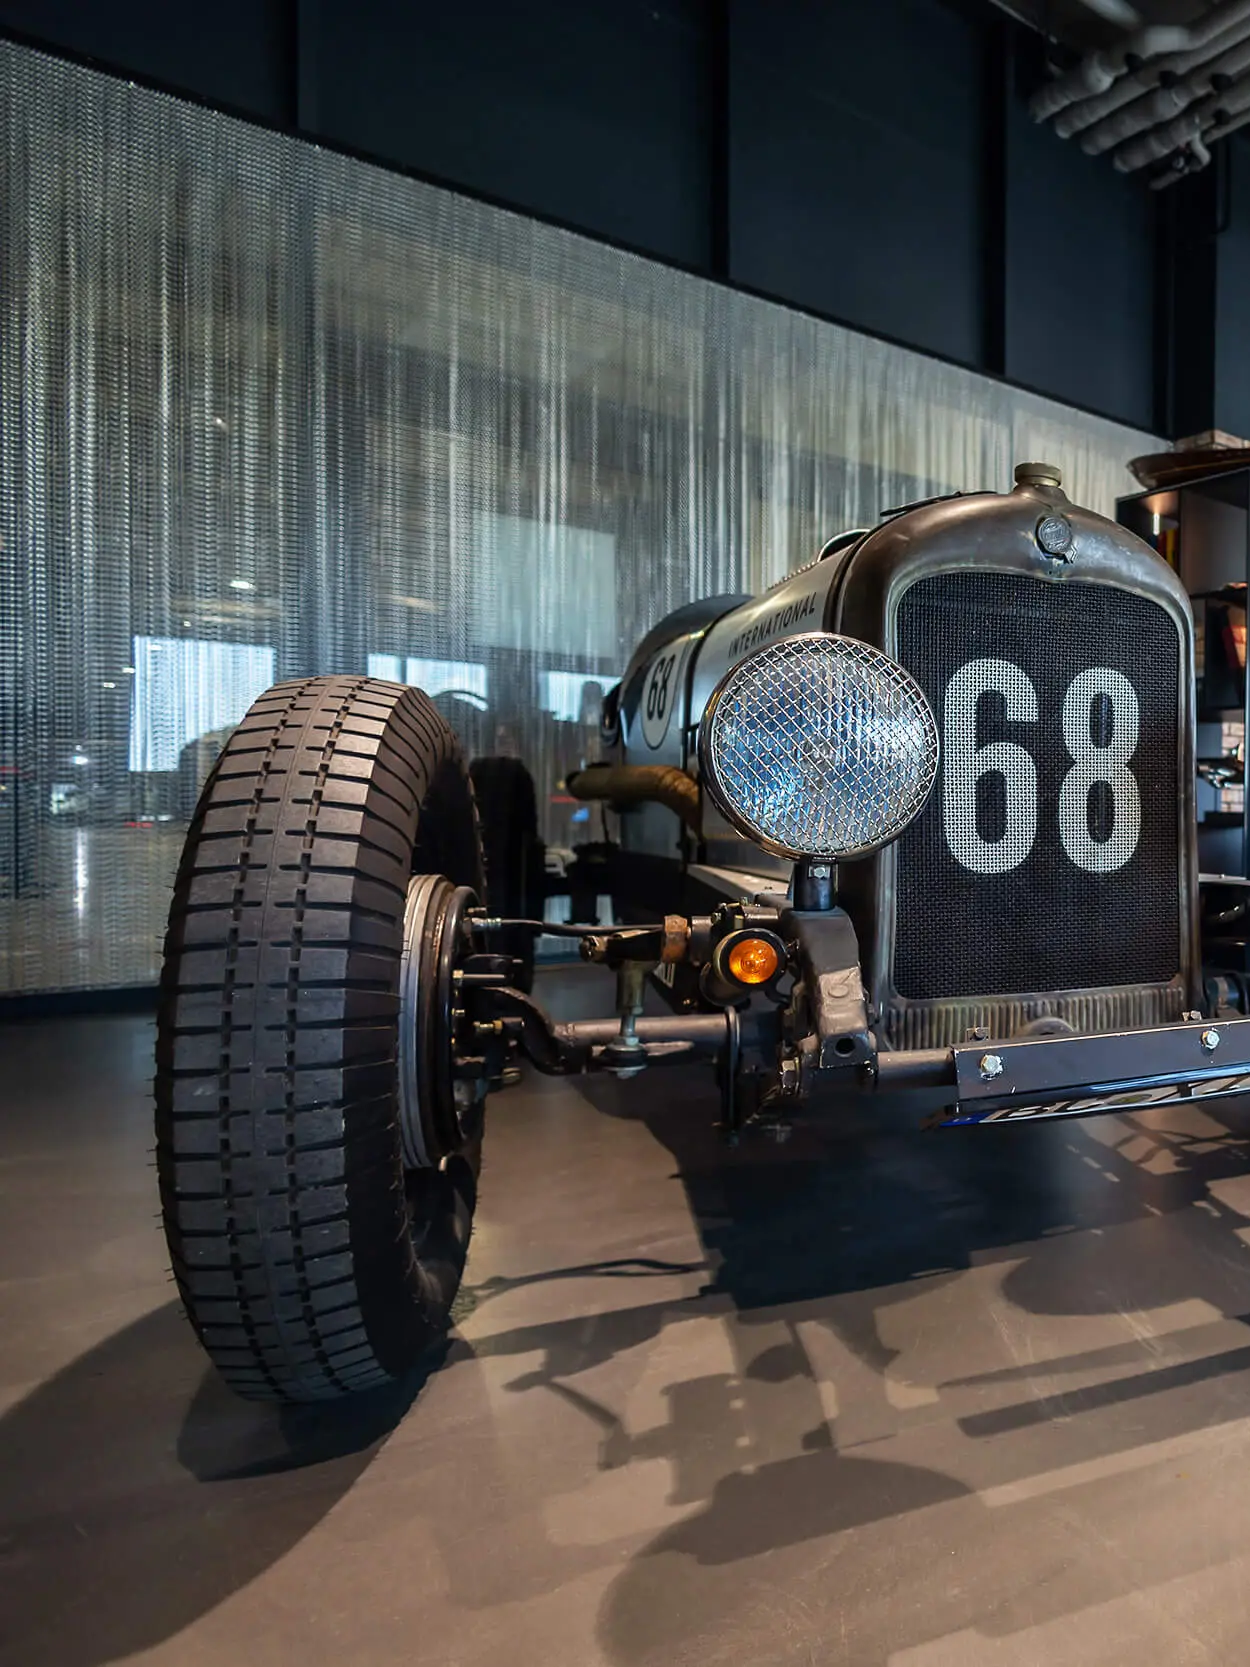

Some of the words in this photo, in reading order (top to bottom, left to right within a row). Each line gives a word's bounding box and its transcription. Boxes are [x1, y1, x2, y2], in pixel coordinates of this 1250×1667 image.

[728, 592, 817, 658] INTERNATIONAL
[647, 654, 676, 720] 68
[944, 658, 1141, 874] 68
